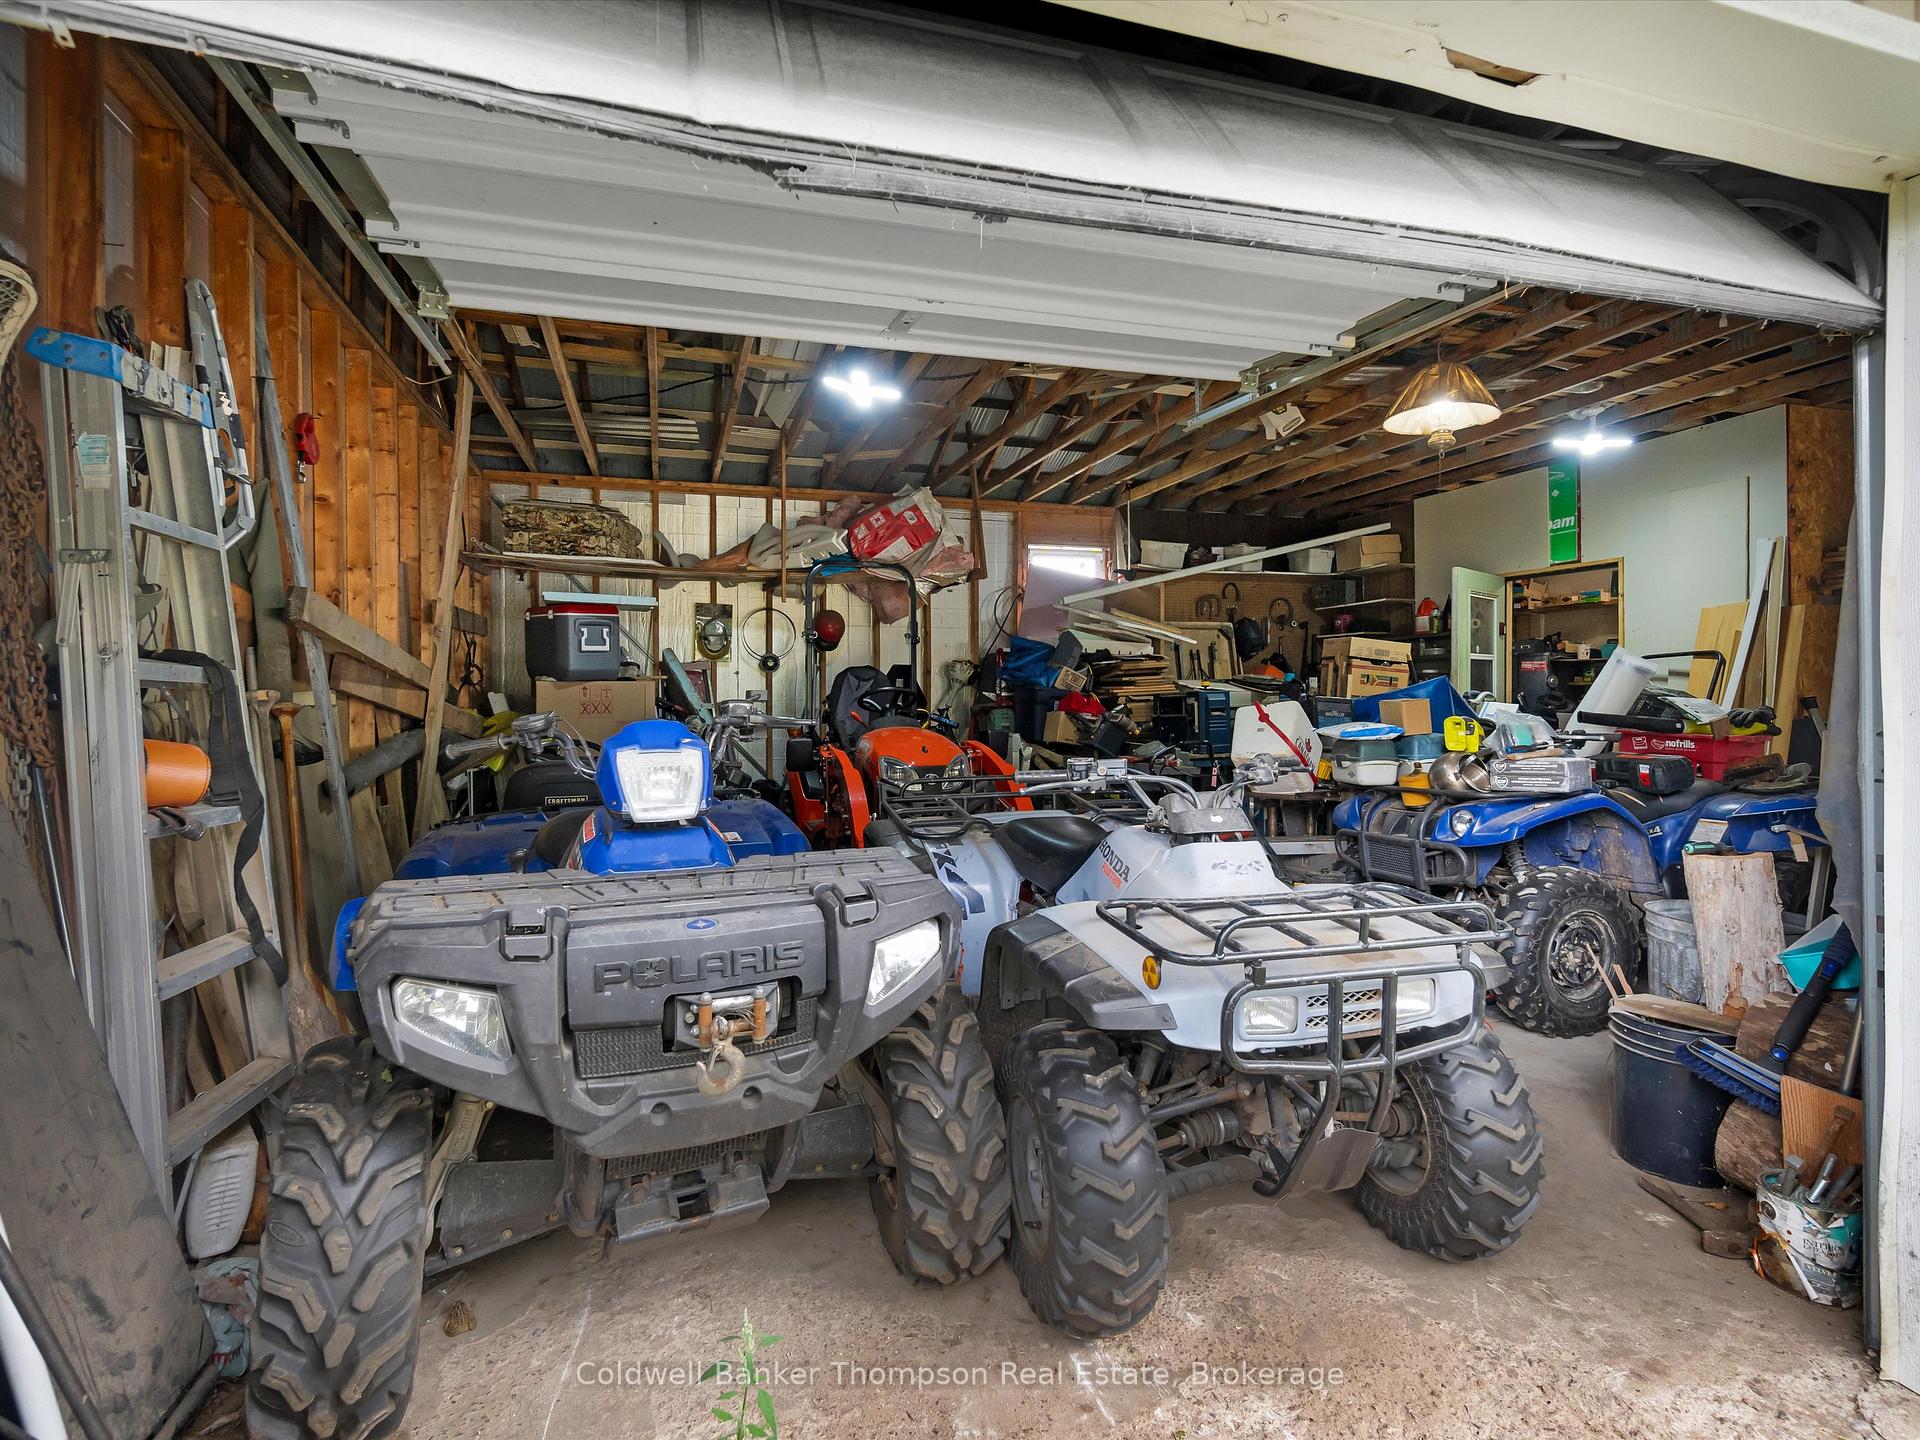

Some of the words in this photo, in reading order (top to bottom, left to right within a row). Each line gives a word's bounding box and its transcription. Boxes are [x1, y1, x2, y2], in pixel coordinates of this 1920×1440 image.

[1665, 739, 1695, 748] nofrills
[547, 797, 586, 805] CRAFTSMAN
[1098, 839, 1131, 883] HONDA
[594, 940, 805, 993] POLARIS
